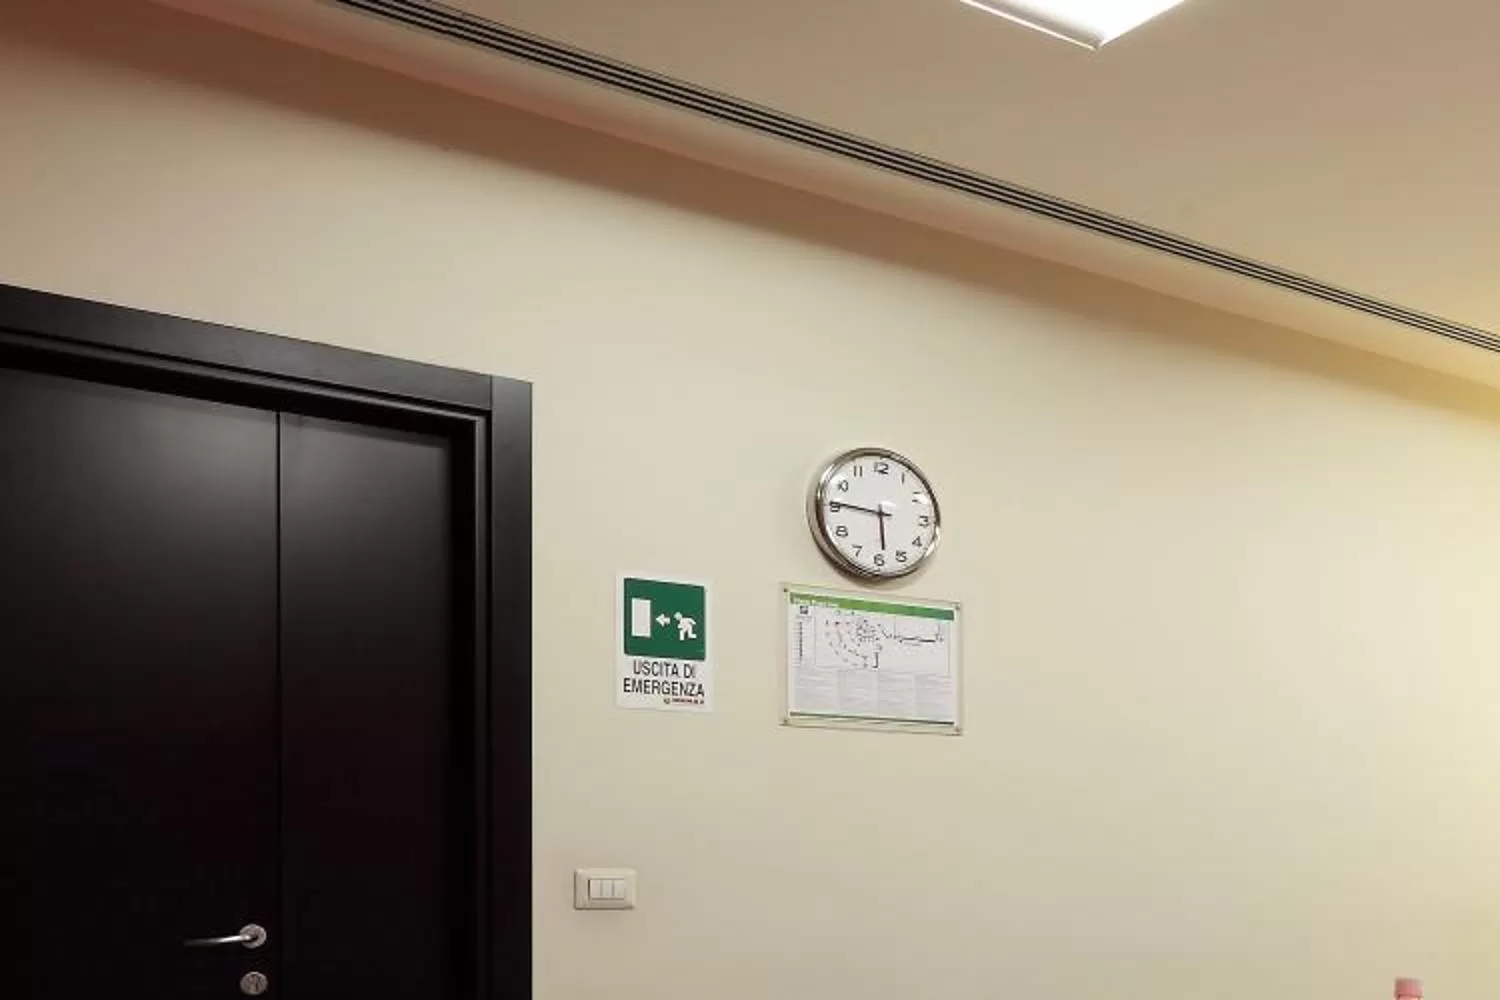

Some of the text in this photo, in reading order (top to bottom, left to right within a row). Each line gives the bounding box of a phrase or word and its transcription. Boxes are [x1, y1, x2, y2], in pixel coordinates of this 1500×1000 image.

[853, 465, 863, 477] 11
[873, 461, 889, 475] 12
[837, 479, 849, 492] 10
[918, 515, 929, 528] 3
[835, 525, 848, 538] 8
[911, 535, 922, 547] 4
[852, 544, 862, 557] 7
[895, 550, 907, 562] 5
[873, 553, 885, 566] 6
[633, 659, 697, 679] USCITA DI
[623, 677, 705, 698] EMERGENZA
